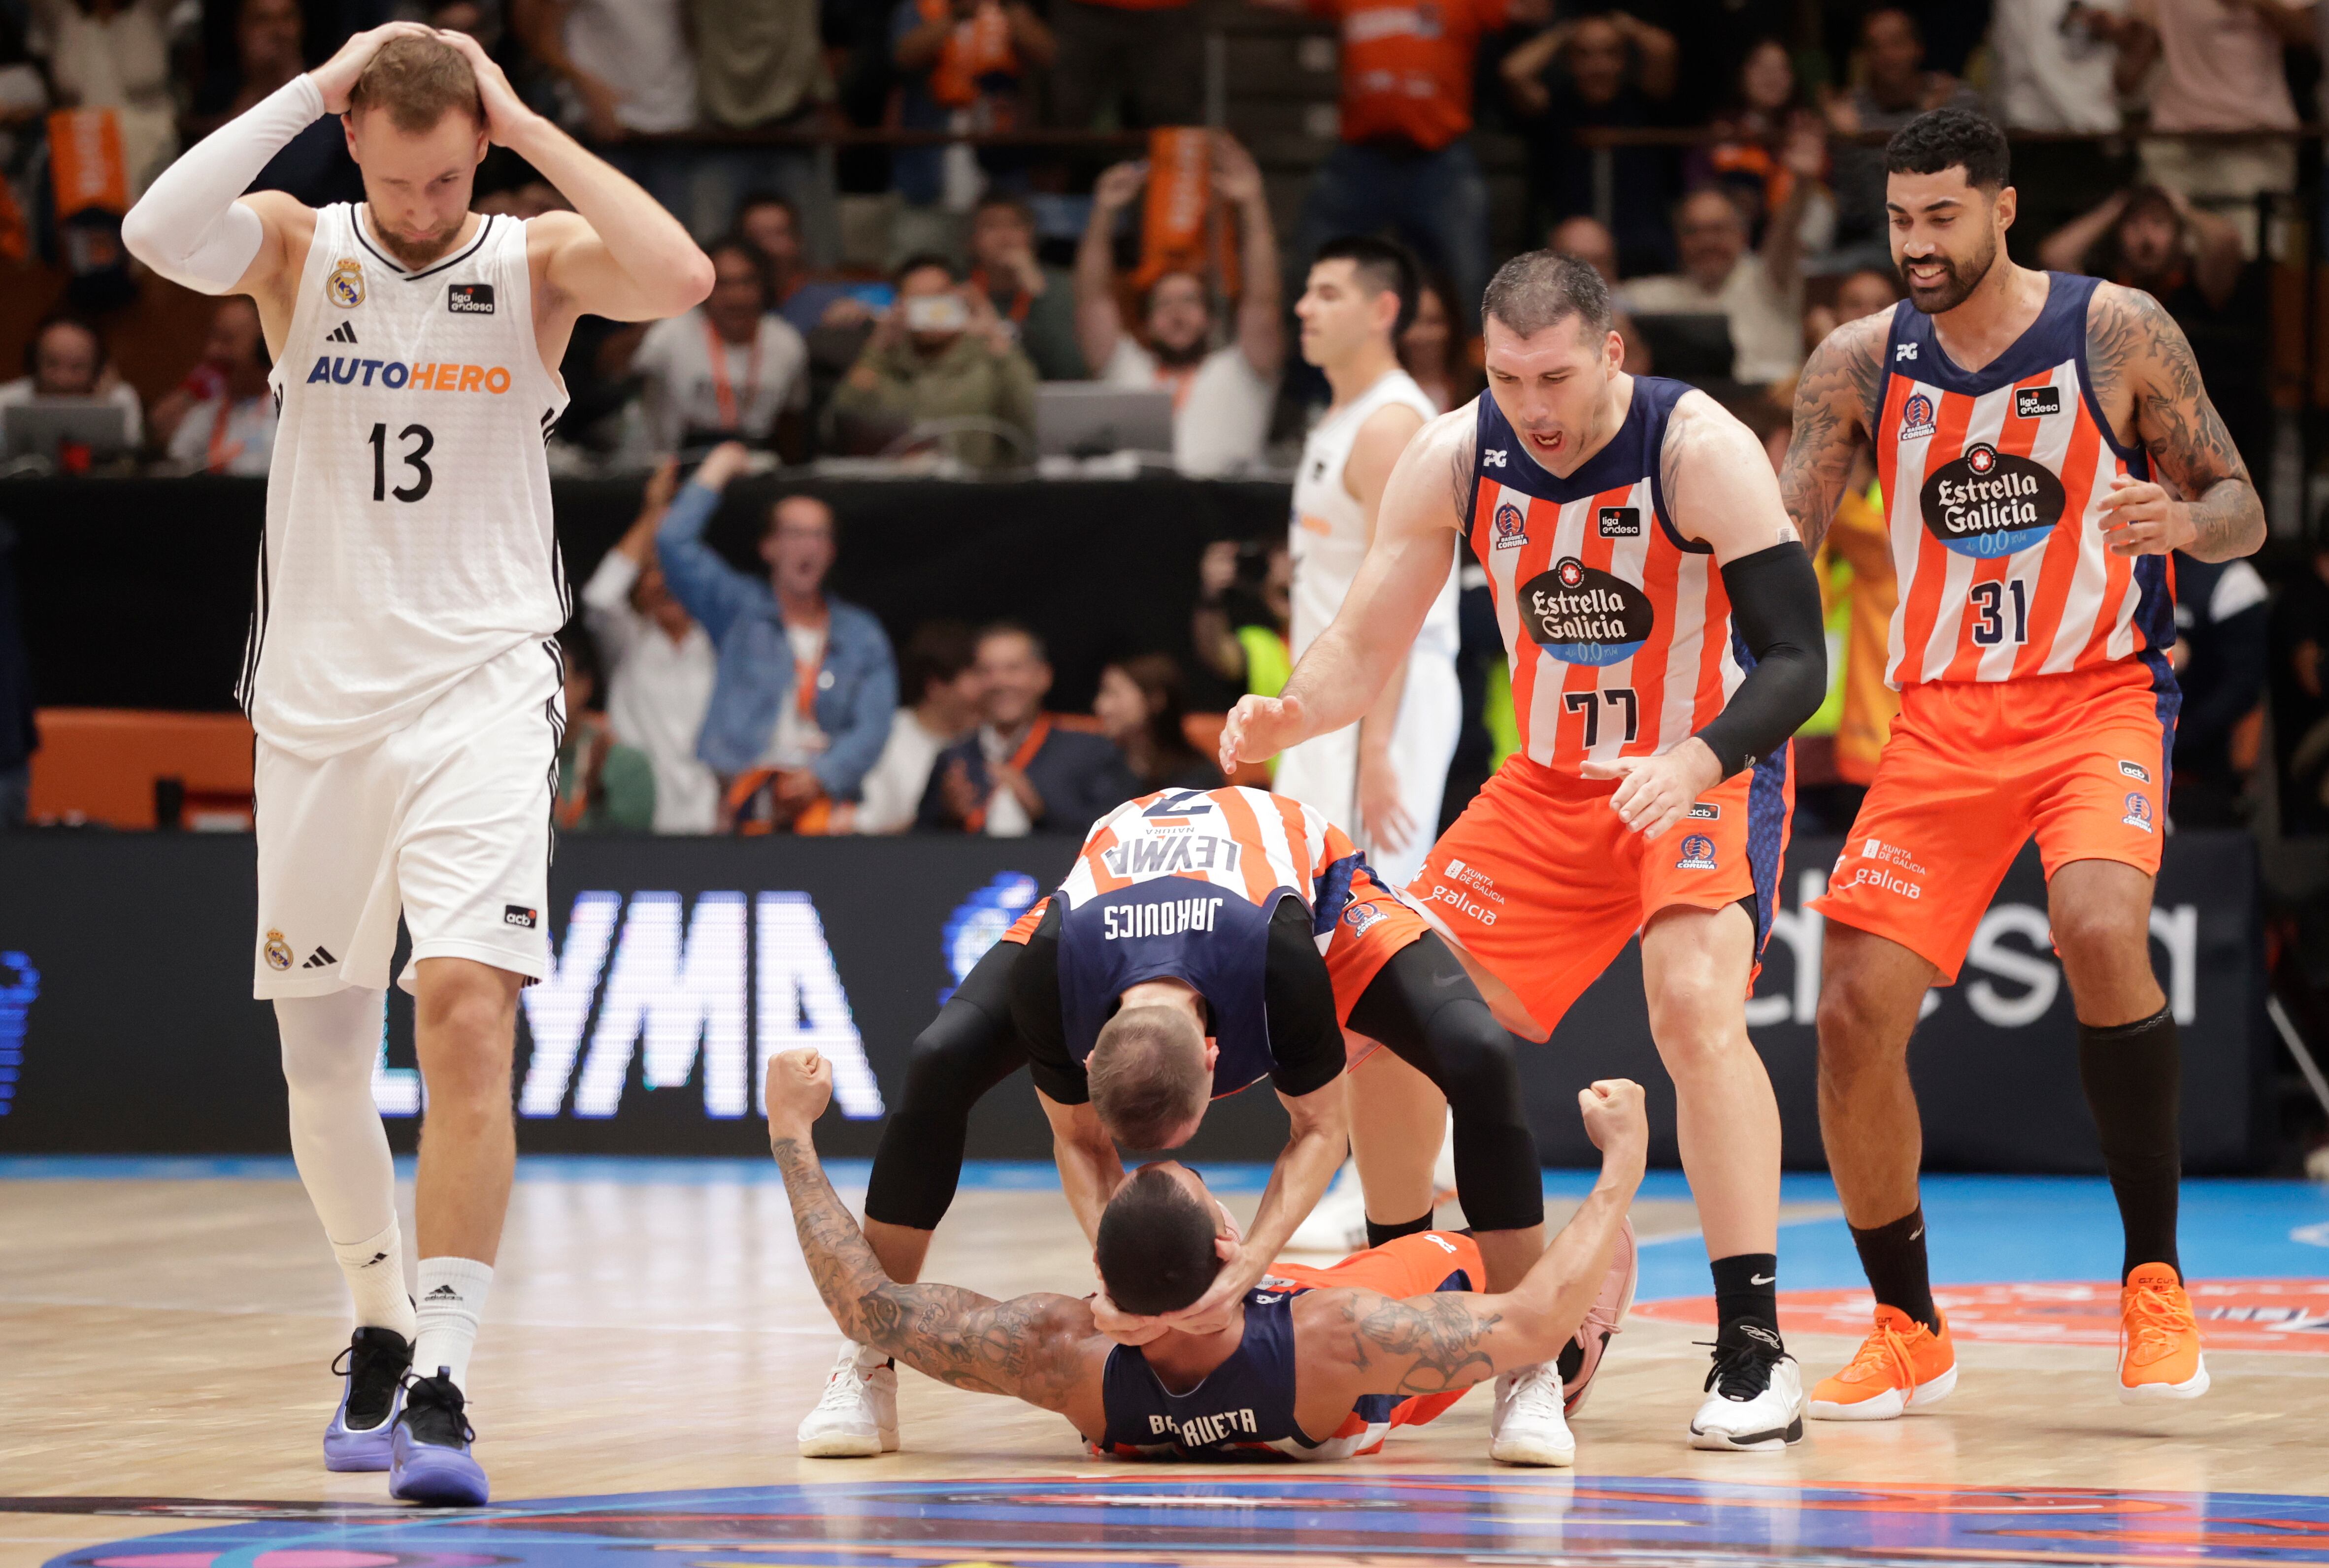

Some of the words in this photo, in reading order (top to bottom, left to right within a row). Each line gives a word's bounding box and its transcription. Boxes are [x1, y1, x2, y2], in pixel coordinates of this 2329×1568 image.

[451, 301, 493, 312] endesa
[452, 292, 471, 303] liga
[306, 356, 511, 394] AUTOHERO
[2020, 397, 2037, 407] liga
[2020, 404, 2058, 415] endesa
[368, 422, 434, 502] 13
[1938, 472, 2039, 506] Estrella
[1602, 516, 1619, 526] liga
[1945, 498, 2038, 533] Galicia
[1602, 524, 1638, 534] endesa
[1979, 528, 2009, 554] 0,0
[1532, 589, 1626, 616] Estrella
[1969, 579, 2028, 646] 31
[1542, 614, 1628, 639] Galicia
[1577, 641, 1602, 662] 0,0
[1563, 687, 1639, 750] 77
[2124, 767, 2145, 779] acb
[1689, 809, 1711, 817] acb
[1105, 836, 1238, 875] LEYMA
[1878, 851, 1892, 862] DE
[1893, 856, 1926, 875] GALICIA
[1882, 844, 1911, 860] XUNTA
[1459, 874, 1473, 884] DE
[1472, 881, 1505, 905] GALICIA
[1464, 867, 1494, 887] XUNTA
[1837, 868, 1921, 899] galicia
[1419, 885, 1497, 926] galicia
[506, 913, 531, 926] acb
[1104, 898, 1223, 941] JAKOVICS
